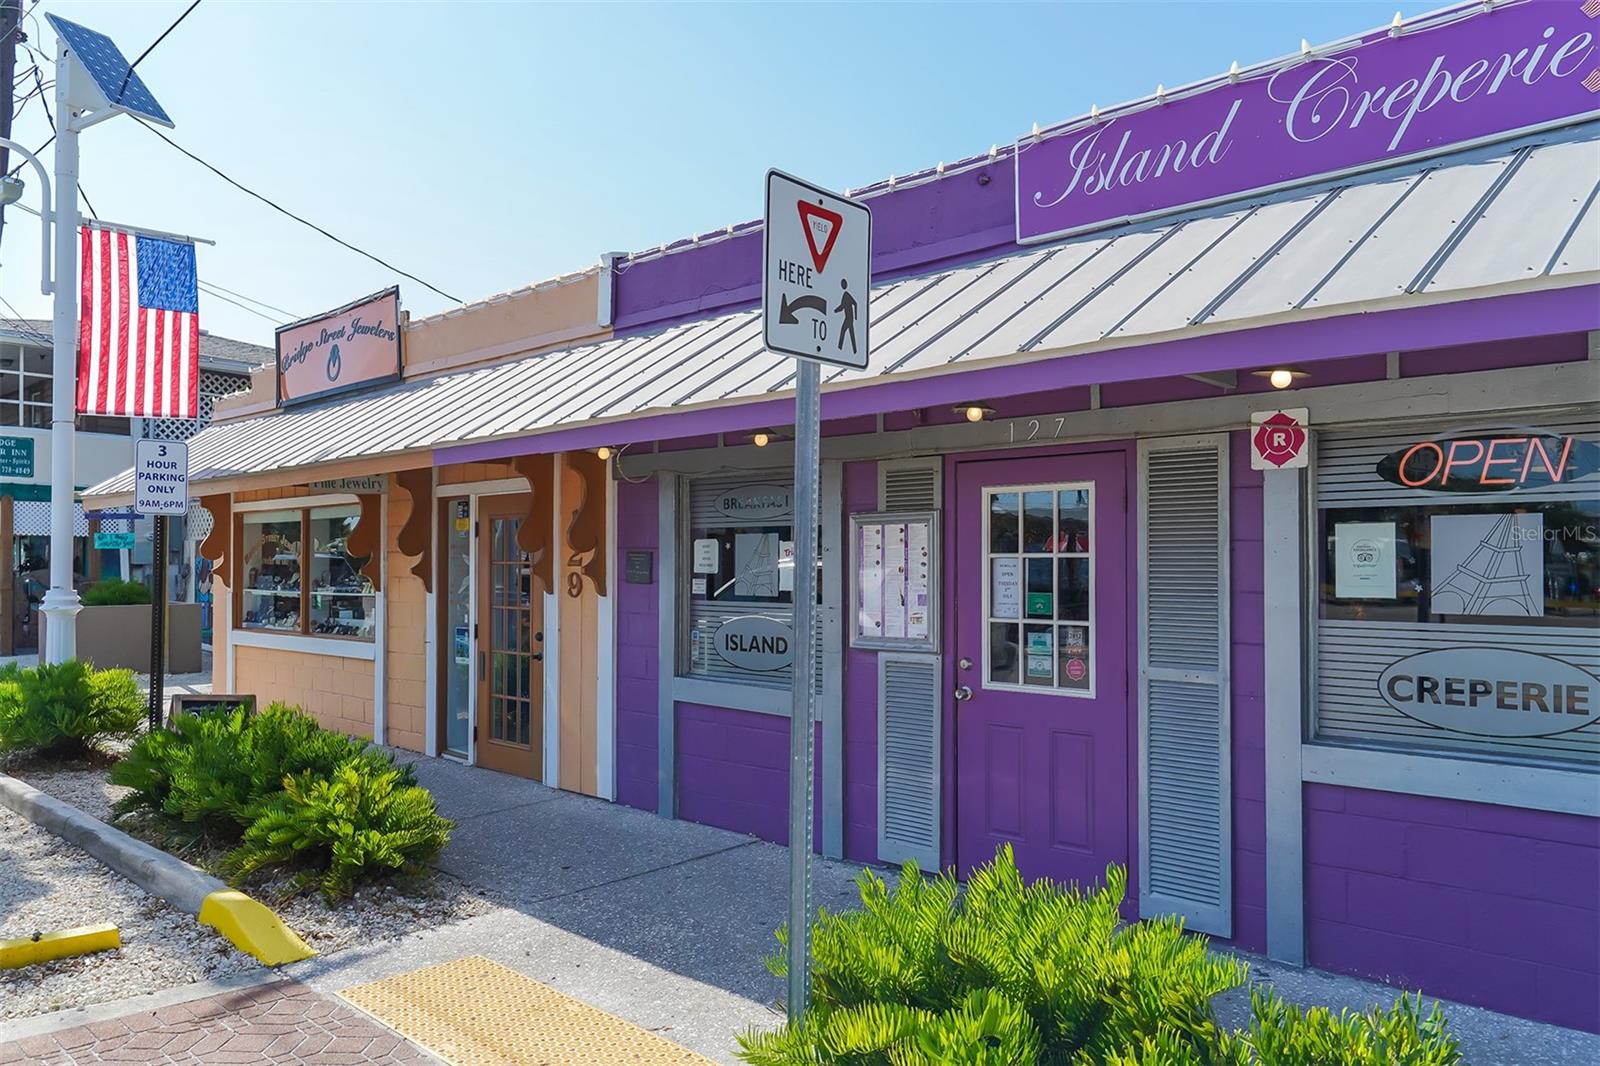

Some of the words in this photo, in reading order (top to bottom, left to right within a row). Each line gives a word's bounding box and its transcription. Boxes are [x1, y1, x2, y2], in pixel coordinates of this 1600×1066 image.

[1033, 98, 1243, 208] Island
[1267, 26, 1594, 152] Creperie
[812, 220, 829, 234] YIELD
[778, 259, 813, 289] HERE
[811, 318, 827, 341] TO
[281, 341, 314, 374] Bridge
[315, 326, 346, 348] Street
[346, 317, 397, 342] Jewelers
[1008, 417, 1065, 443] 127
[1273, 432, 1286, 446] R
[11, 448, 27, 457] INN
[157, 445, 168, 457] 3
[146, 460, 178, 470] HOUR
[1397, 436, 1573, 487] OPEN
[138, 472, 185, 483] PARKING
[339, 477, 384, 492] Jewelry
[147, 484, 176, 495] ONLY
[139, 499, 184, 509] 9AM-6PM
[724, 633, 788, 655] ISLAND
[1387, 674, 1590, 716] CREPERIE
